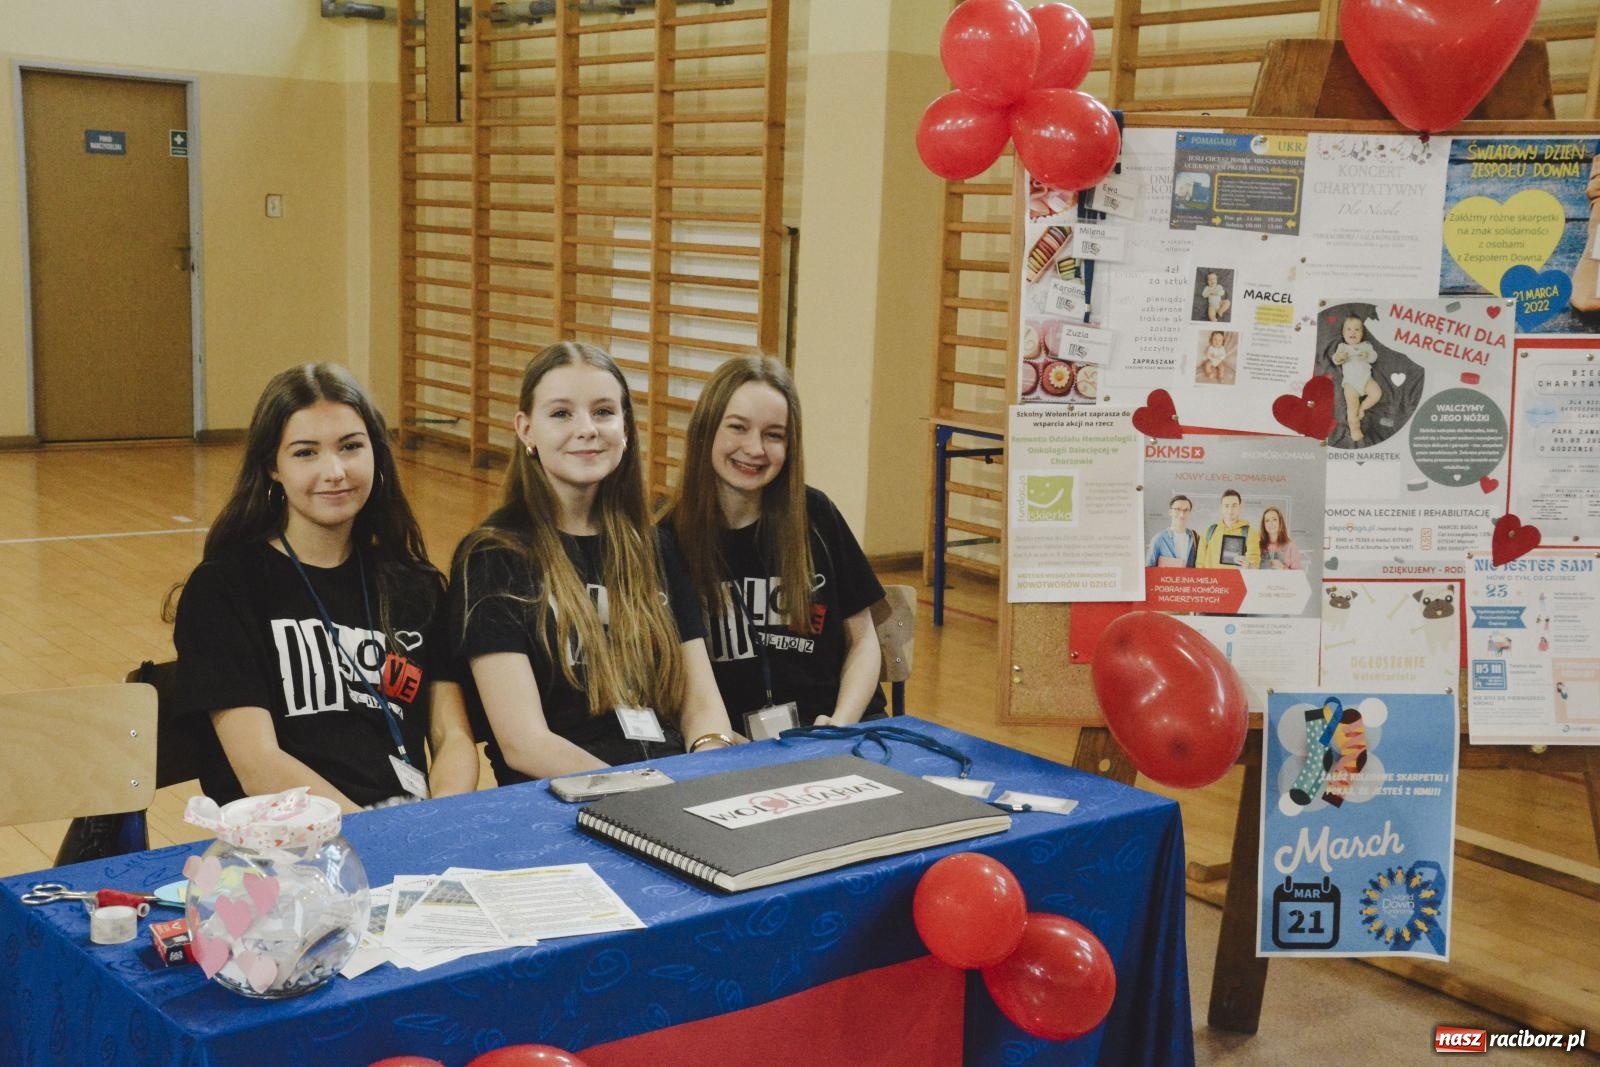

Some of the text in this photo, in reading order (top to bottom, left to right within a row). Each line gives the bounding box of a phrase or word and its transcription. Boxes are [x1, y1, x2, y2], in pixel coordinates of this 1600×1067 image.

[1191, 136, 1238, 146] POMAGAMY
[1468, 139, 1587, 161] ŚWIATOWY DZIEŃ
[1338, 165, 1406, 178] KONCERT
[1471, 163, 1580, 179] ZESPOŁU DOWNA
[1313, 182, 1428, 197] CHARYTATYWNY
[1079, 227, 1106, 237] Milena
[1457, 228, 1469, 236] na
[1471, 227, 1492, 236] znak
[1486, 239, 1525, 249] osobami
[1243, 288, 1294, 304] MARCEL
[1525, 285, 1560, 299] MARCA
[1524, 300, 1550, 314] 2022
[1389, 303, 1506, 349] NAKRĘTKI DLA
[1066, 328, 1088, 338] Zuzia
[1394, 327, 1490, 366] MARCELKA!
[1436, 404, 1485, 413] WALCZYMY
[1431, 412, 1490, 422] O JEGO NÓŻKI
[1082, 434, 1134, 444] Hematologii
[1027, 447, 1067, 455] Onkologii
[1068, 447, 1110, 455] Dziecięcej
[1145, 445, 1190, 459] DKMS
[1356, 452, 1401, 462] NAKRĘTEK
[1175, 471, 1205, 481] NOWY
[1206, 472, 1233, 482] LEVEL
[1027, 509, 1072, 522] iskierka
[1325, 508, 1356, 517] OMOC
[1358, 508, 1372, 517] NA
[1374, 508, 1417, 517] LECZENIE
[1423, 509, 1491, 518] REHABILITACJĘ
[1382, 565, 1437, 576] DZIĘKUJEMY
[1559, 559, 1593, 572] SAM
[1016, 579, 1080, 589] NOWOTWORÓW
[1089, 580, 1117, 588] DZIECI
[1160, 576, 1194, 584] KOLEJNA
[1191, 584, 1230, 594] KOMÓREK
[1158, 595, 1220, 604] MACIERZYSTYCH
[1396, 773, 1443, 783] SKARPETKI
[1273, 820, 1405, 875] March
[1294, 888, 1321, 899] MAR
[1382, 898, 1415, 909] Down
[1288, 909, 1325, 934] 21
